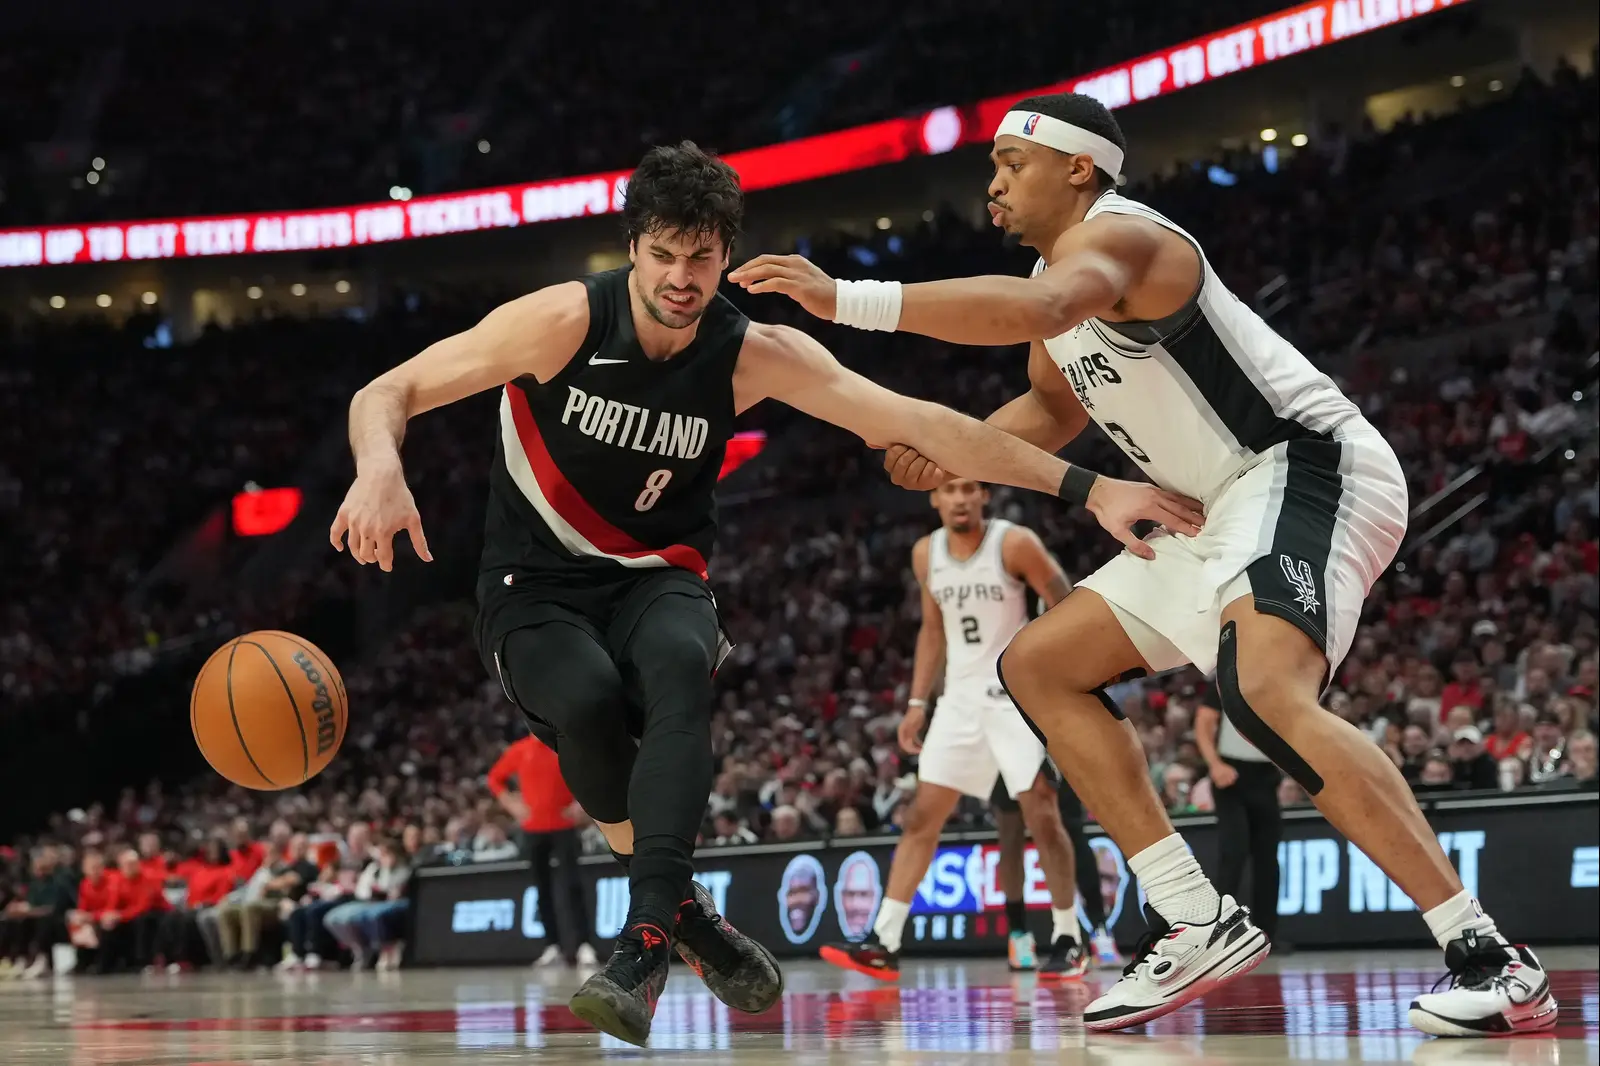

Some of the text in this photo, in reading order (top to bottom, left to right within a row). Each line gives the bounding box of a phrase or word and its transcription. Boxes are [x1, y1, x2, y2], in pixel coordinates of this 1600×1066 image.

[1131, 57, 1168, 101] UP
[1169, 45, 1205, 88] TO
[1207, 27, 1257, 77] GET
[1258, 6, 1327, 61] TEXT
[45, 228, 84, 264] UP
[87, 226, 123, 262] TO
[126, 222, 178, 260] GET
[182, 217, 250, 256] TEXT
[252, 212, 352, 252] ALERTS
[354, 205, 404, 244] FOR
[406, 191, 520, 237] TICKETS,
[522, 178, 608, 223] DROPS
[561, 385, 709, 460] PORTLAND
[634, 469, 673, 512] 8
[960, 615, 981, 644] 2
[292, 648, 336, 757] Wilson
[1276, 838, 1340, 916] UP
[1347, 830, 1486, 913] NT
[912, 913, 967, 941] THE
